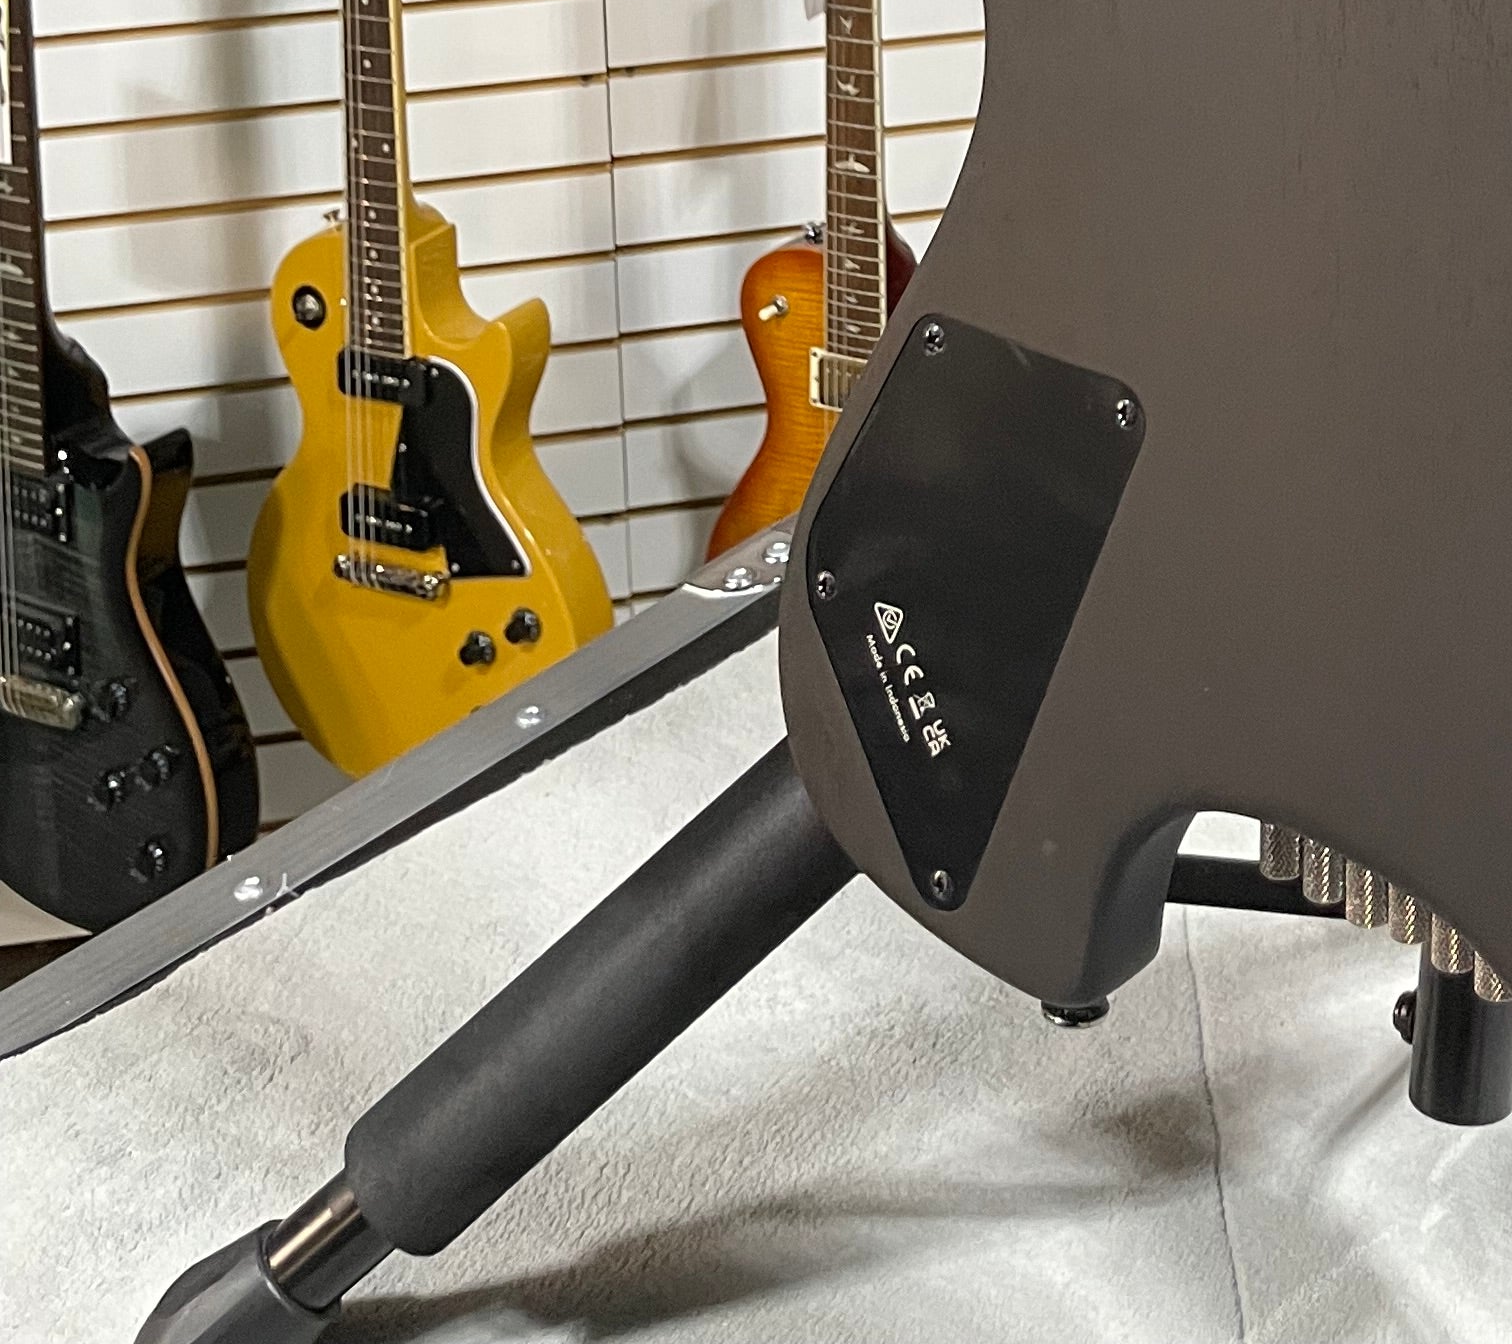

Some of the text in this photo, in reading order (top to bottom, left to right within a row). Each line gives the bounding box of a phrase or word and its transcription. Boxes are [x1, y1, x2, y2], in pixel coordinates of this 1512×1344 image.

[866, 634, 911, 743] Made in Indonesia
